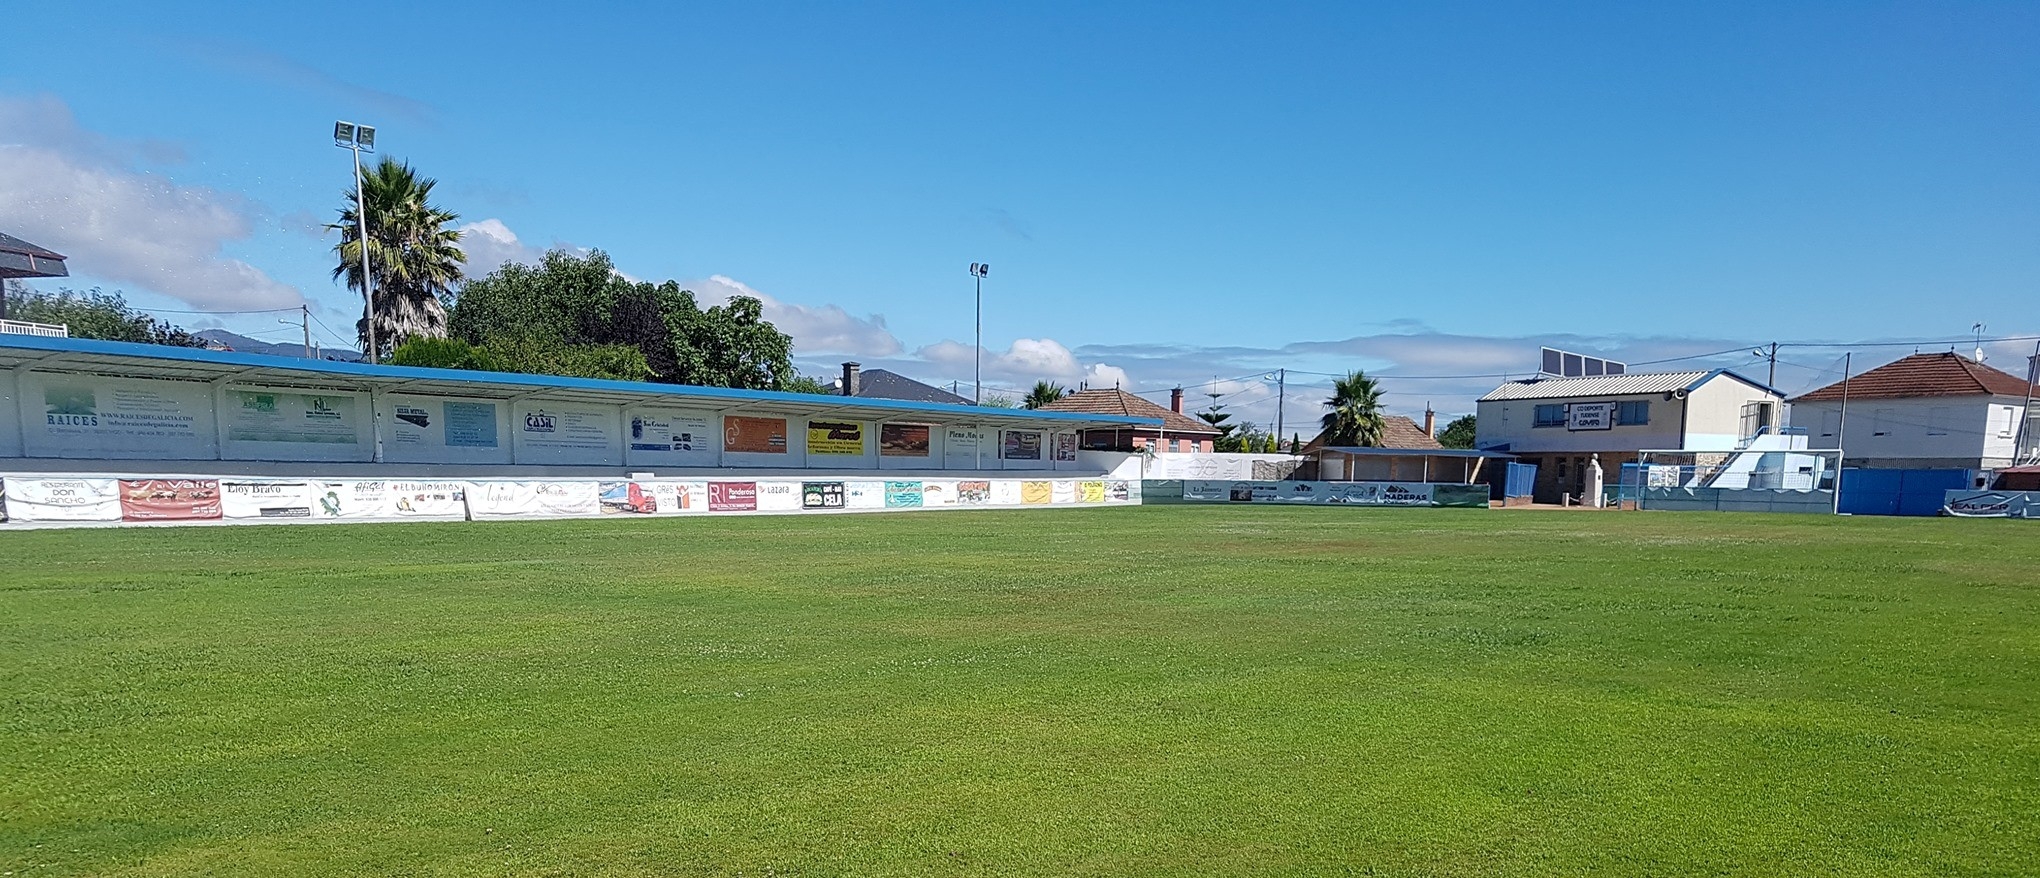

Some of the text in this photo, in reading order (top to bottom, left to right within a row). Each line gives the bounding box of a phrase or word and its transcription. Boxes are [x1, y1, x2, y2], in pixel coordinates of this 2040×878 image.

[47, 414, 98, 427] RAICES
[823, 494, 843, 506] CELA
[1383, 493, 1427, 501] MADERAS
